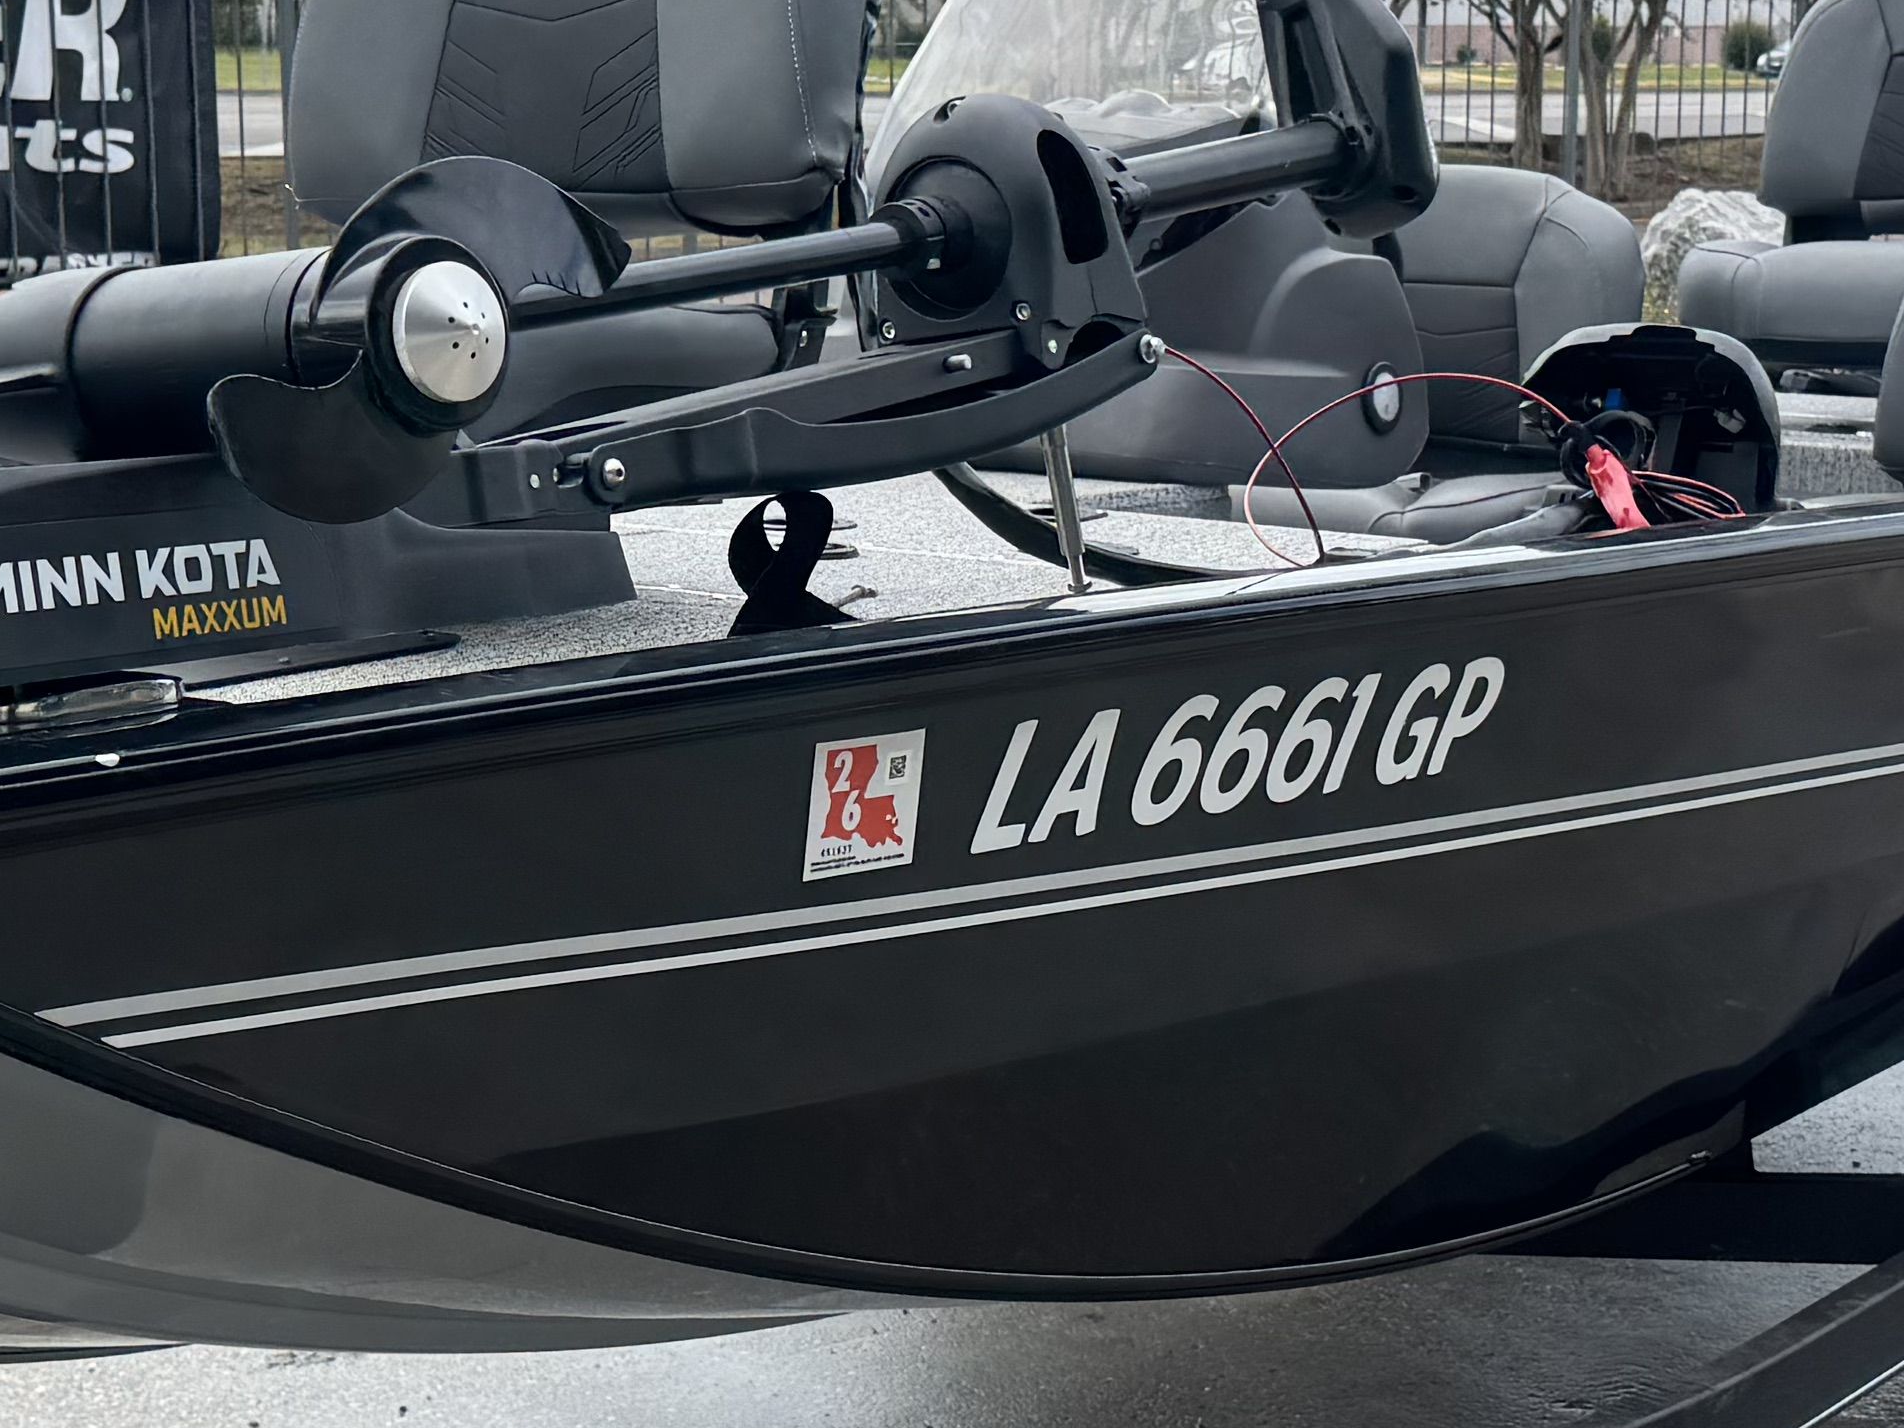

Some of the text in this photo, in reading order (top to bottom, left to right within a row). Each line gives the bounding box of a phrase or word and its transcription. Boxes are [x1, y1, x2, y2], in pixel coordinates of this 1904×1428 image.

[135, 538, 281, 599] KOTA
[153, 594, 287, 640] MAXXUM
[832, 750, 853, 793] 2
[970, 657, 1505, 854] LA 6661 GP
[842, 789, 862, 831] 6
